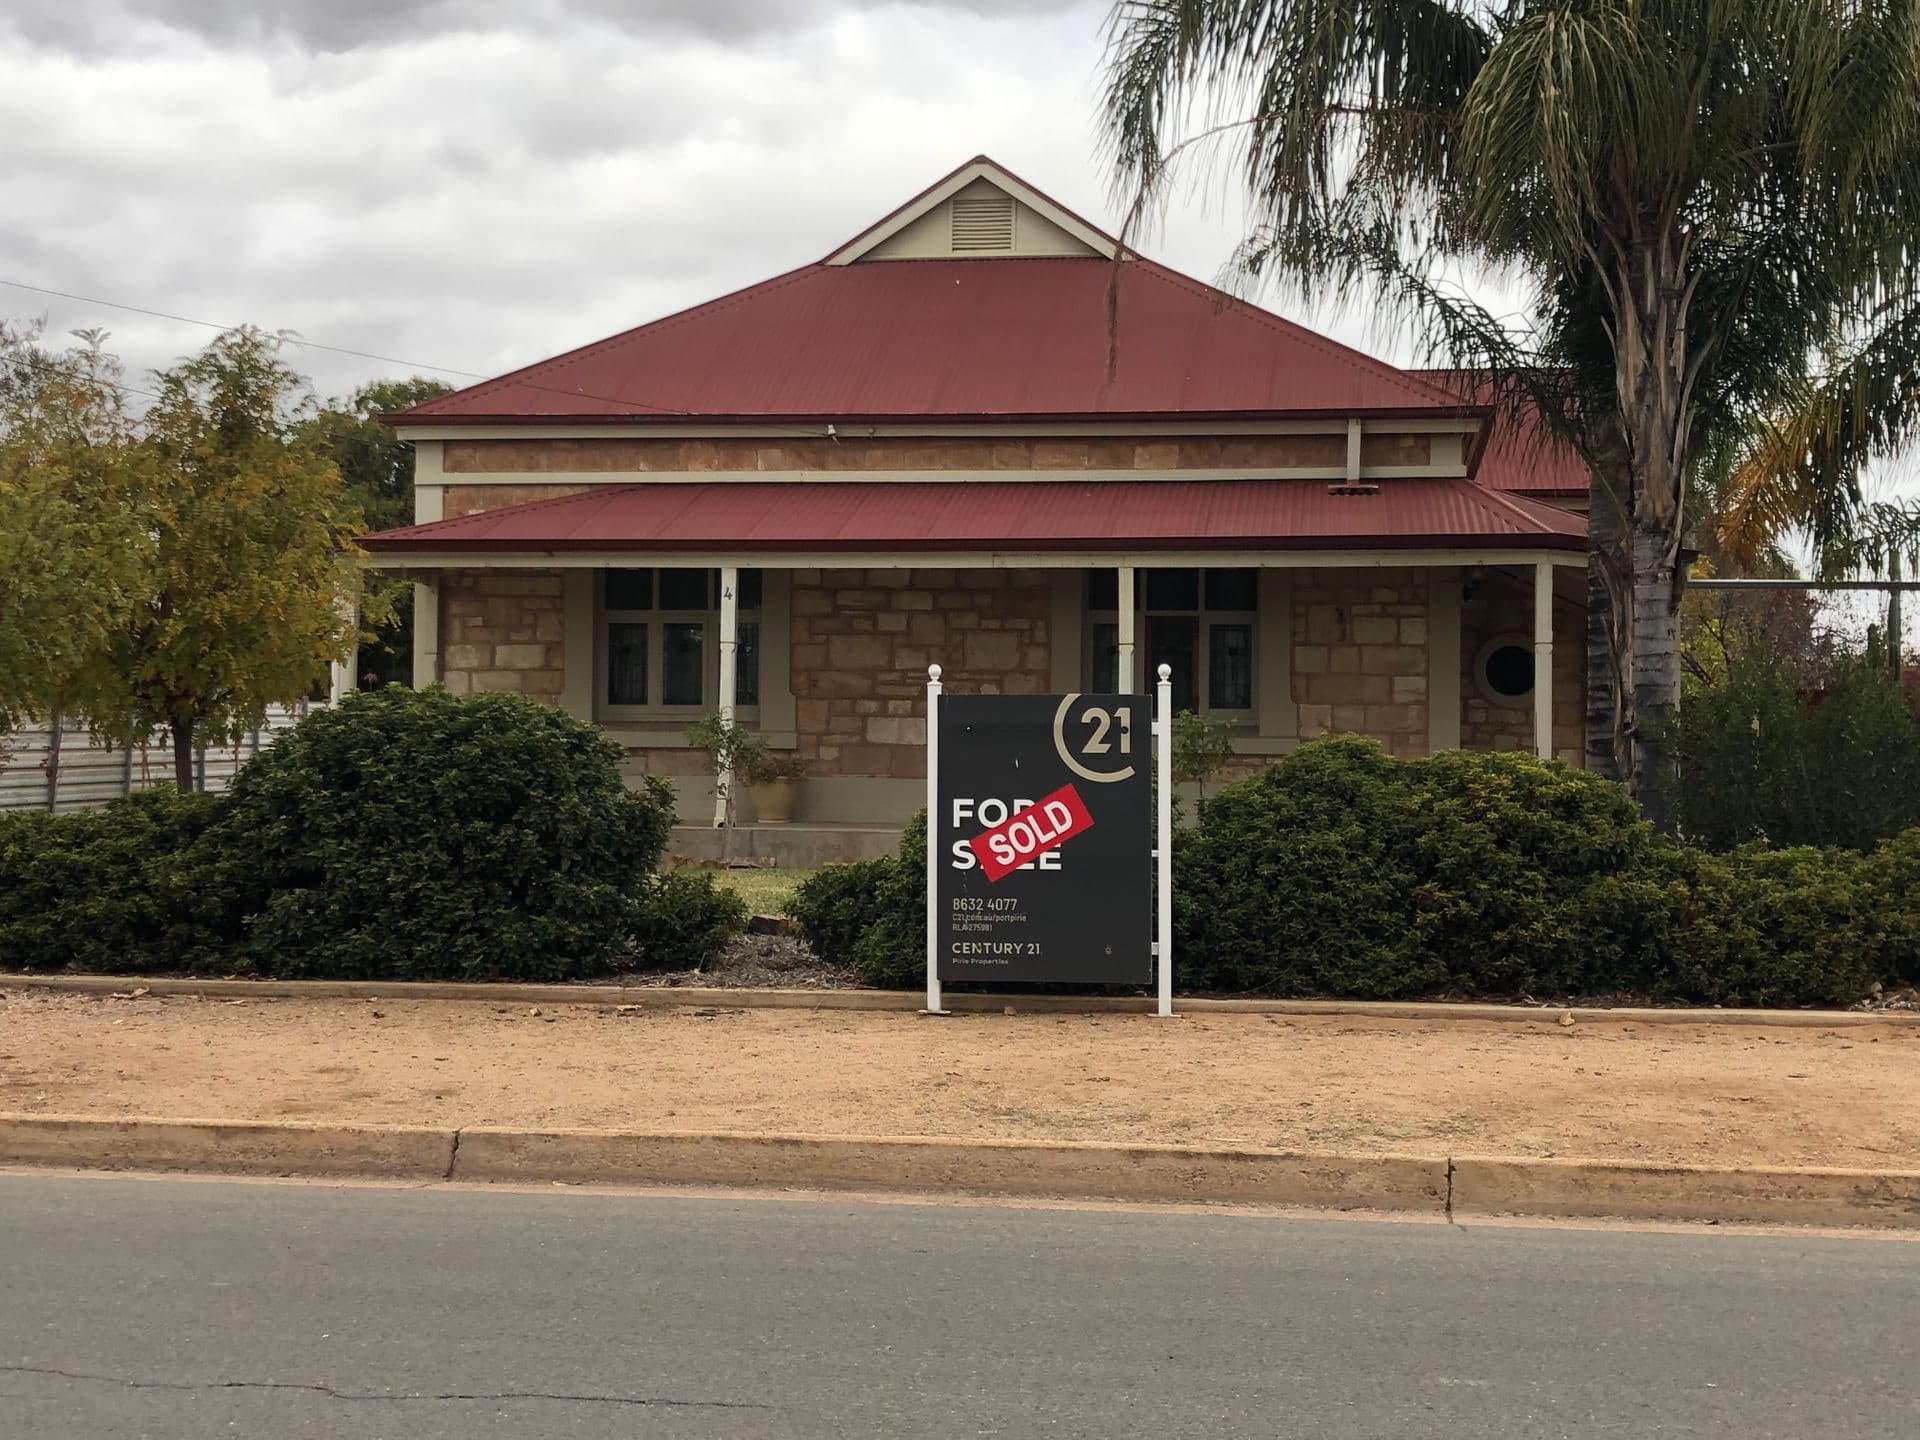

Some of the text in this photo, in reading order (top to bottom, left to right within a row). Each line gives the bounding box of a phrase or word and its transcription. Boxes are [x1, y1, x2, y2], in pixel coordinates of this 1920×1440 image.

[724, 586, 733, 600] 4
[988, 800, 1073, 866] SOLD
[951, 839, 1062, 870] SE
[952, 898, 1018, 911] 8632 4077
[951, 942, 1040, 955] CENTURY 21
[971, 958, 1009, 966] Properties
